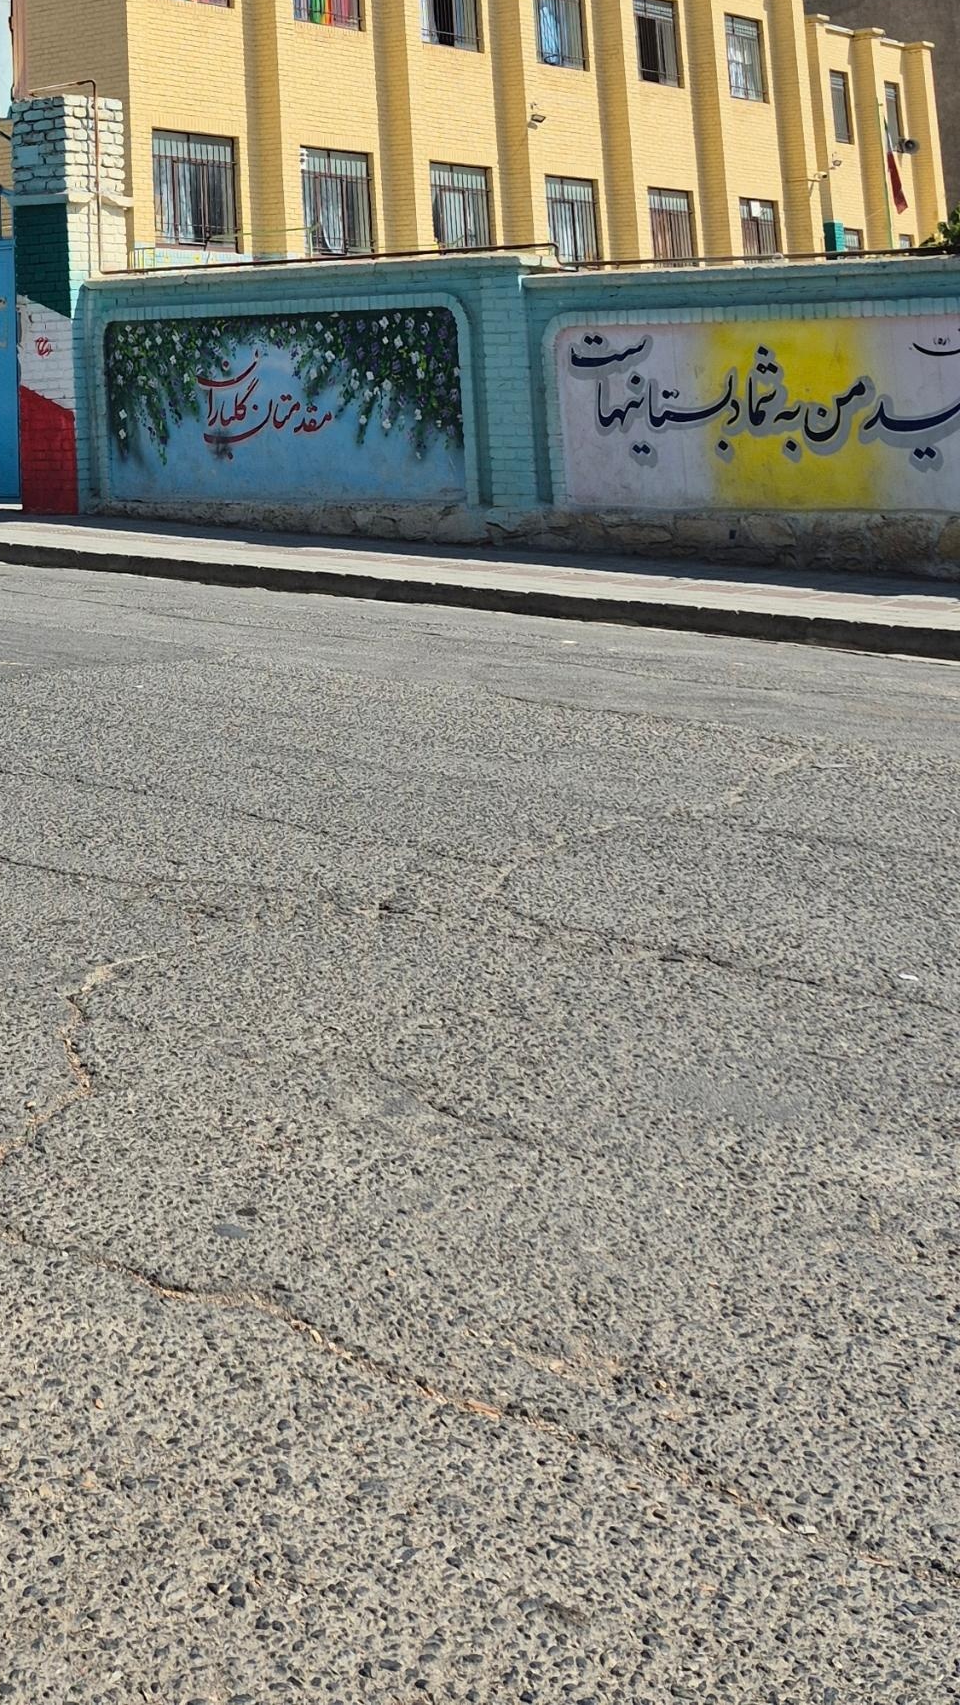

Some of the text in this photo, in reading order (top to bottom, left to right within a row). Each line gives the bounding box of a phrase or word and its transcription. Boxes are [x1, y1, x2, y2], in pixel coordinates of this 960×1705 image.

[748, 345, 779, 427] شما
[804, 379, 867, 443] من
[773, 405, 801, 452] به
[862, 400, 960, 460] ید
